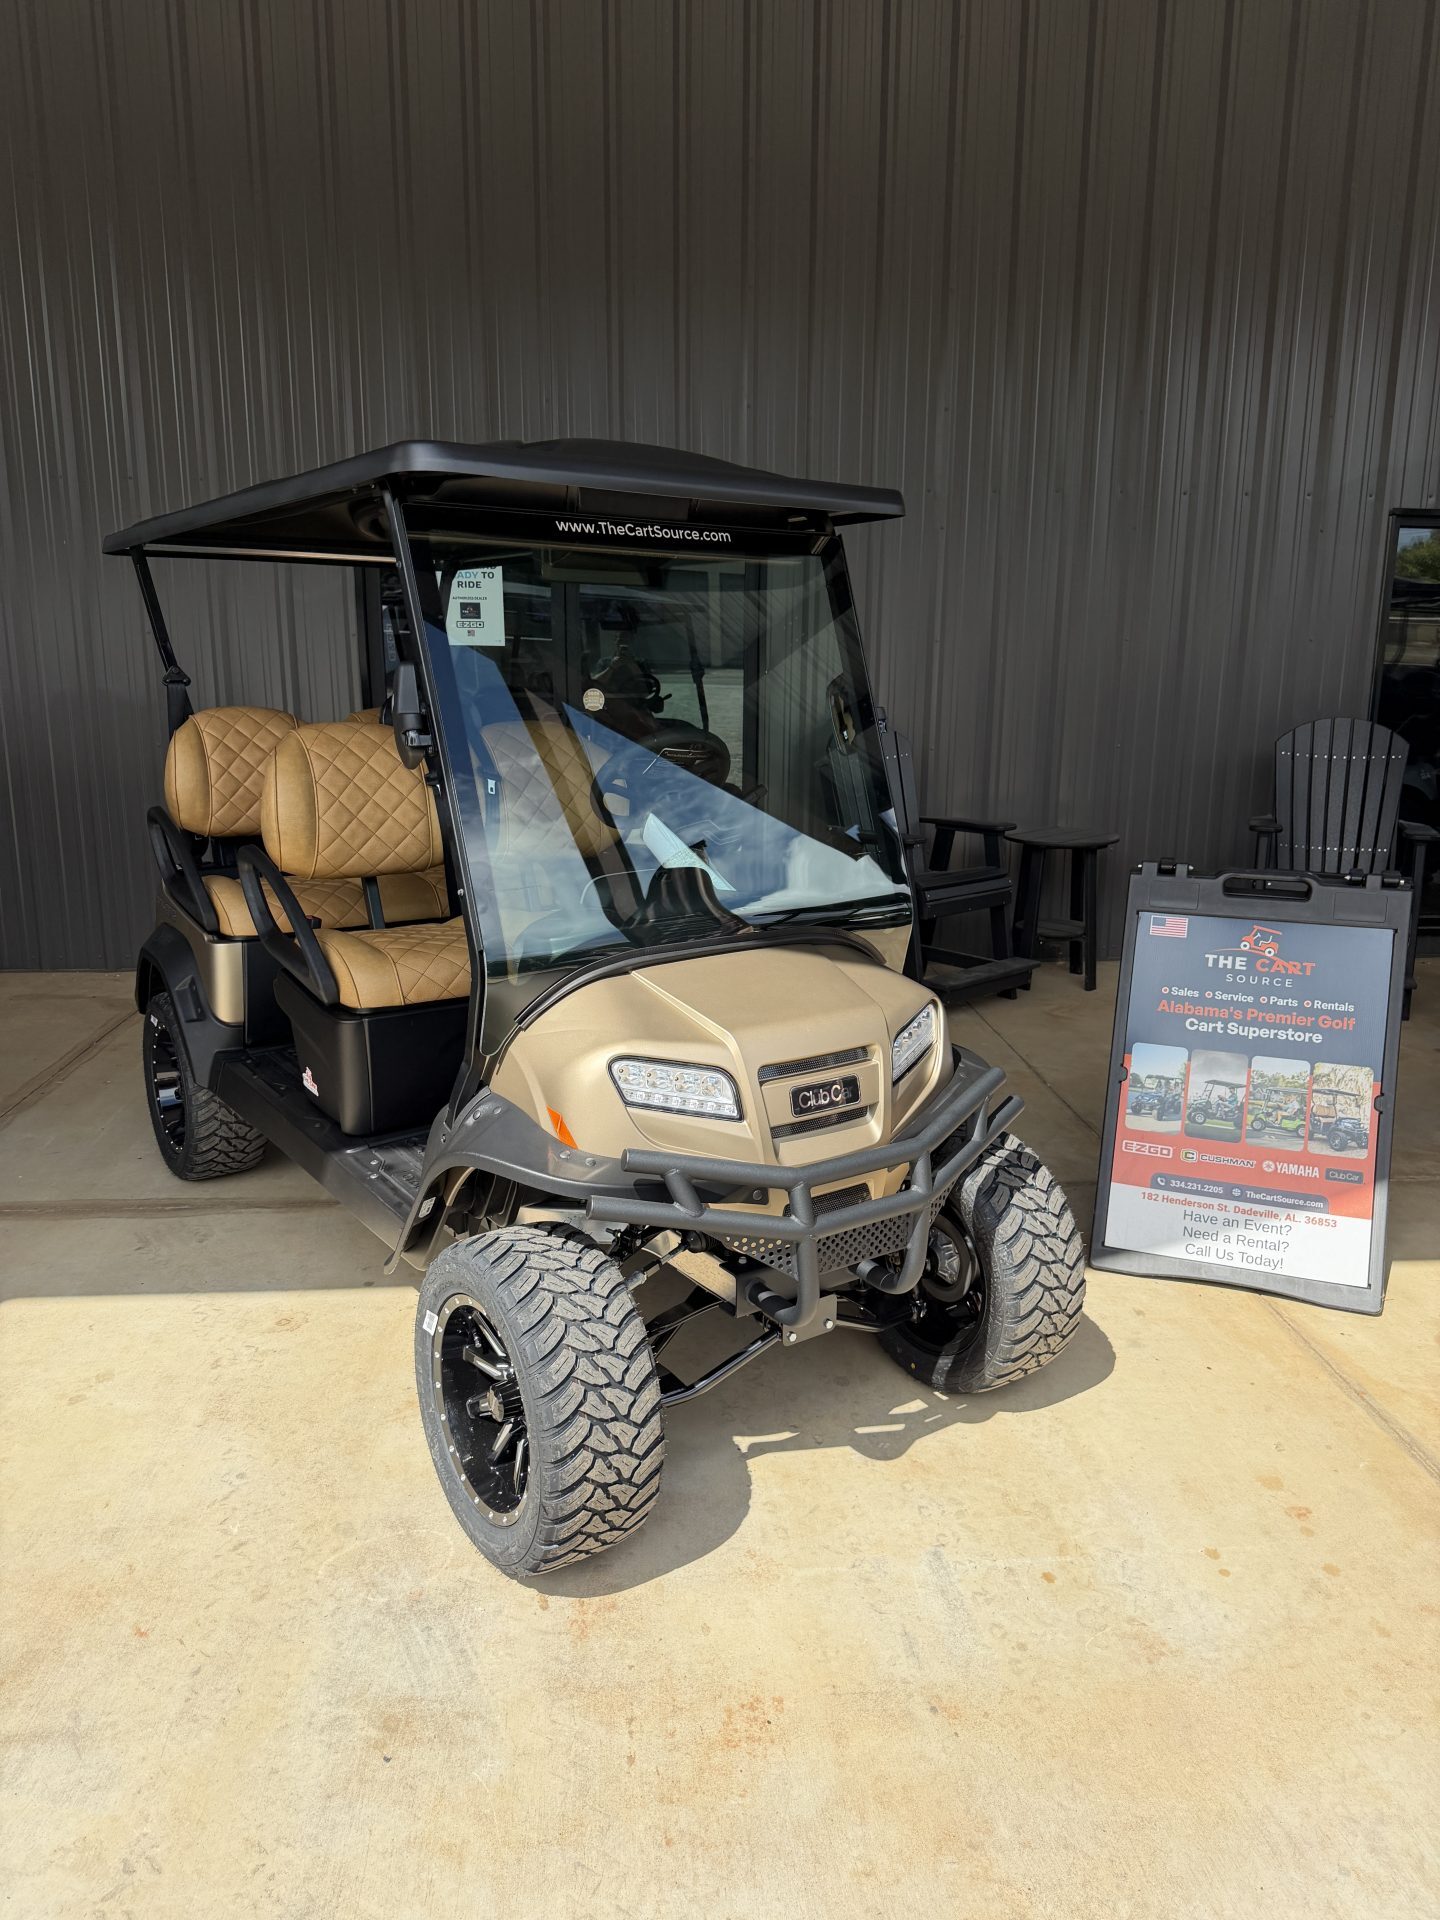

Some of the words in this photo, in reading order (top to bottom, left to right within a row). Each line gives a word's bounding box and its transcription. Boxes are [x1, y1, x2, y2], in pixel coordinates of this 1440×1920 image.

[556, 520, 732, 543] www.TheCartSource.com
[456, 571, 479, 579] ADY
[481, 571, 495, 579] TO
[457, 581, 482, 589] RIDE
[1205, 954, 1248, 970] THE
[1255, 958, 1316, 976] CART
[1225, 973, 1293, 987] SOURCE
[1170, 986, 1199, 998] Sales
[1214, 990, 1254, 1003] Service
[1269, 996, 1299, 1007] Parts
[1313, 1000, 1355, 1012] Rentals
[1157, 999, 1243, 1019] Alabama's
[1246, 1008, 1315, 1026] Premier
[1317, 1015, 1356, 1031] Golf
[1185, 1017, 1224, 1034] Cart
[1226, 1022, 1323, 1043] Superstore
[798, 1088, 830, 1108] Club
[1200, 1154, 1256, 1168] CUSHMAN
[1276, 1161, 1320, 1178] YAMAHA
[1169, 1179, 1224, 1194] 334.231.2205
[1246, 1190, 1324, 1209] TheCartSource.com
[1140, 1192, 1159, 1201] 182
[1162, 1194, 1214, 1210] Henderson
[1217, 1203, 1230, 1212] St.
[1233, 1205, 1282, 1221] Dadeville,
[1284, 1213, 1302, 1223] AL.
[1304, 1216, 1337, 1228] 36853
[1183, 1209, 1218, 1225] Have
[1222, 1217, 1239, 1229] an
[1243, 1218, 1293, 1236] Event?
[1182, 1226, 1219, 1242] Need
[1223, 1233, 1231, 1244] a
[1236, 1234, 1290, 1253] Rental?
[1185, 1243, 1211, 1258] Call
[1215, 1247, 1234, 1261] Us
[1238, 1251, 1284, 1271] Today!
